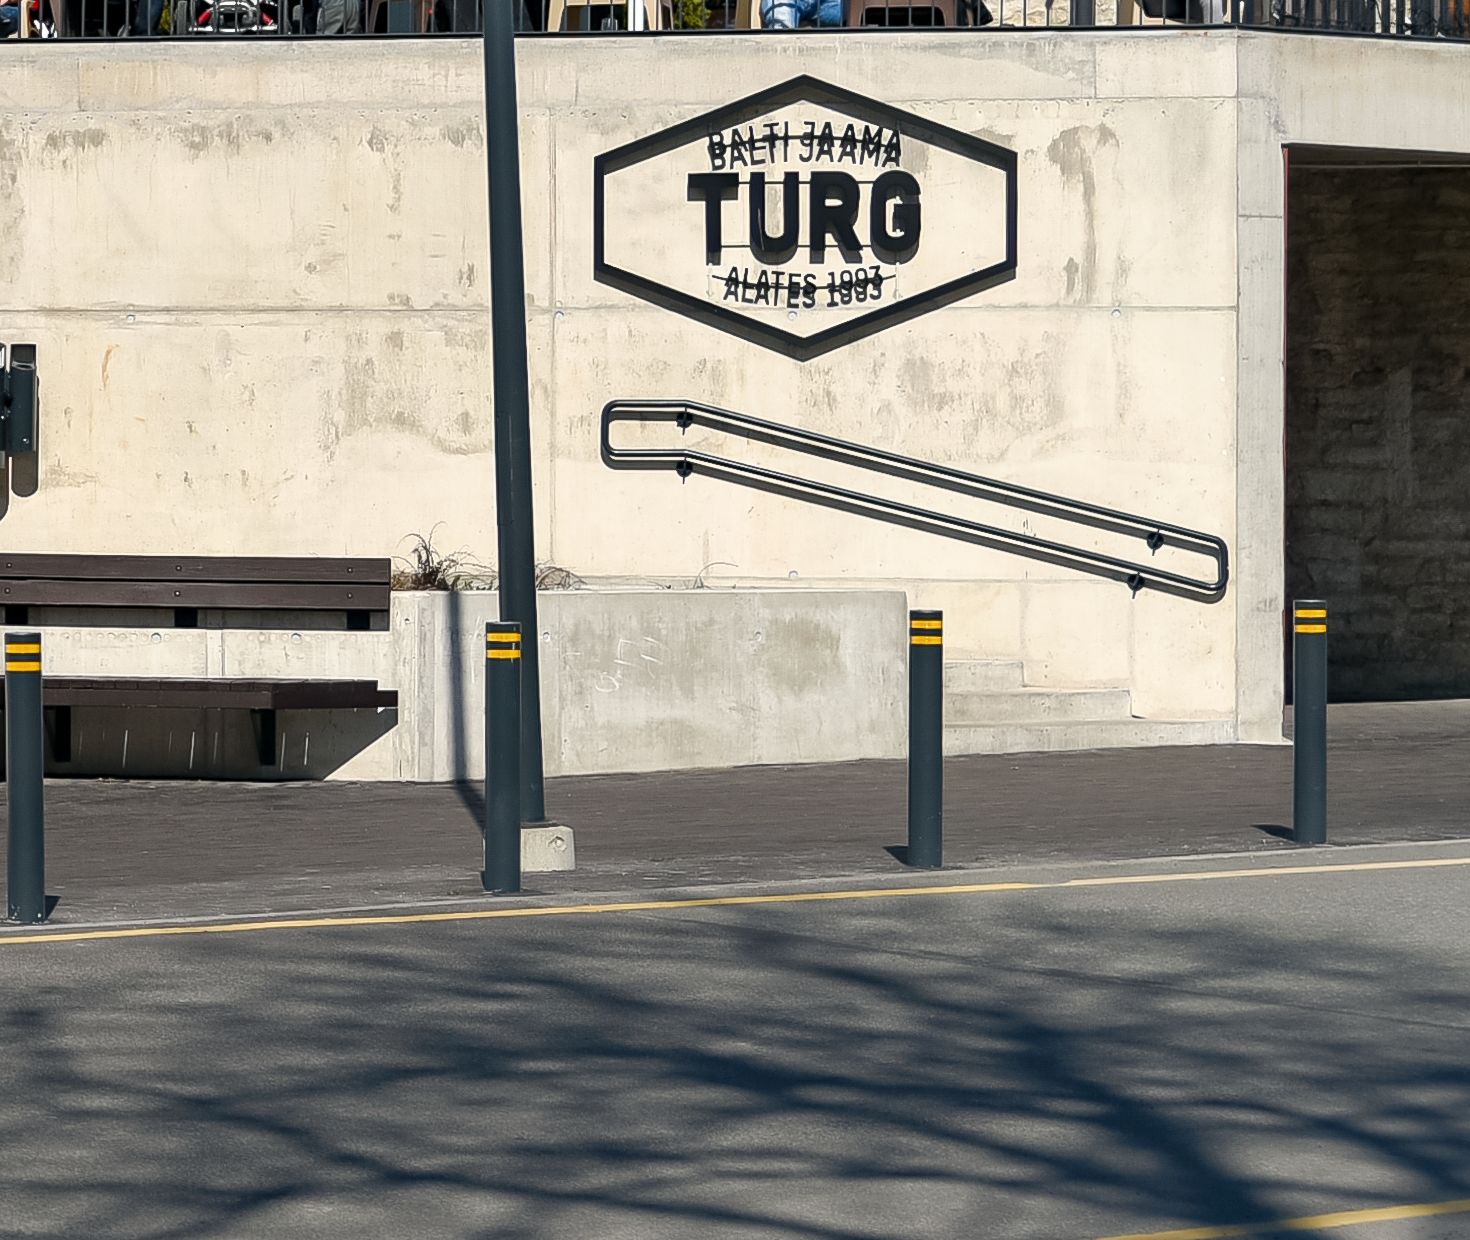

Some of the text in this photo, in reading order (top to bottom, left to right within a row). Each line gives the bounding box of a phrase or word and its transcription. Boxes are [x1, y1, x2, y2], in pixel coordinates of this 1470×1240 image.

[708, 121, 902, 158] BALTI JAAMA
[687, 170, 922, 254] TURG
[724, 265, 884, 294] ALATES 1993
